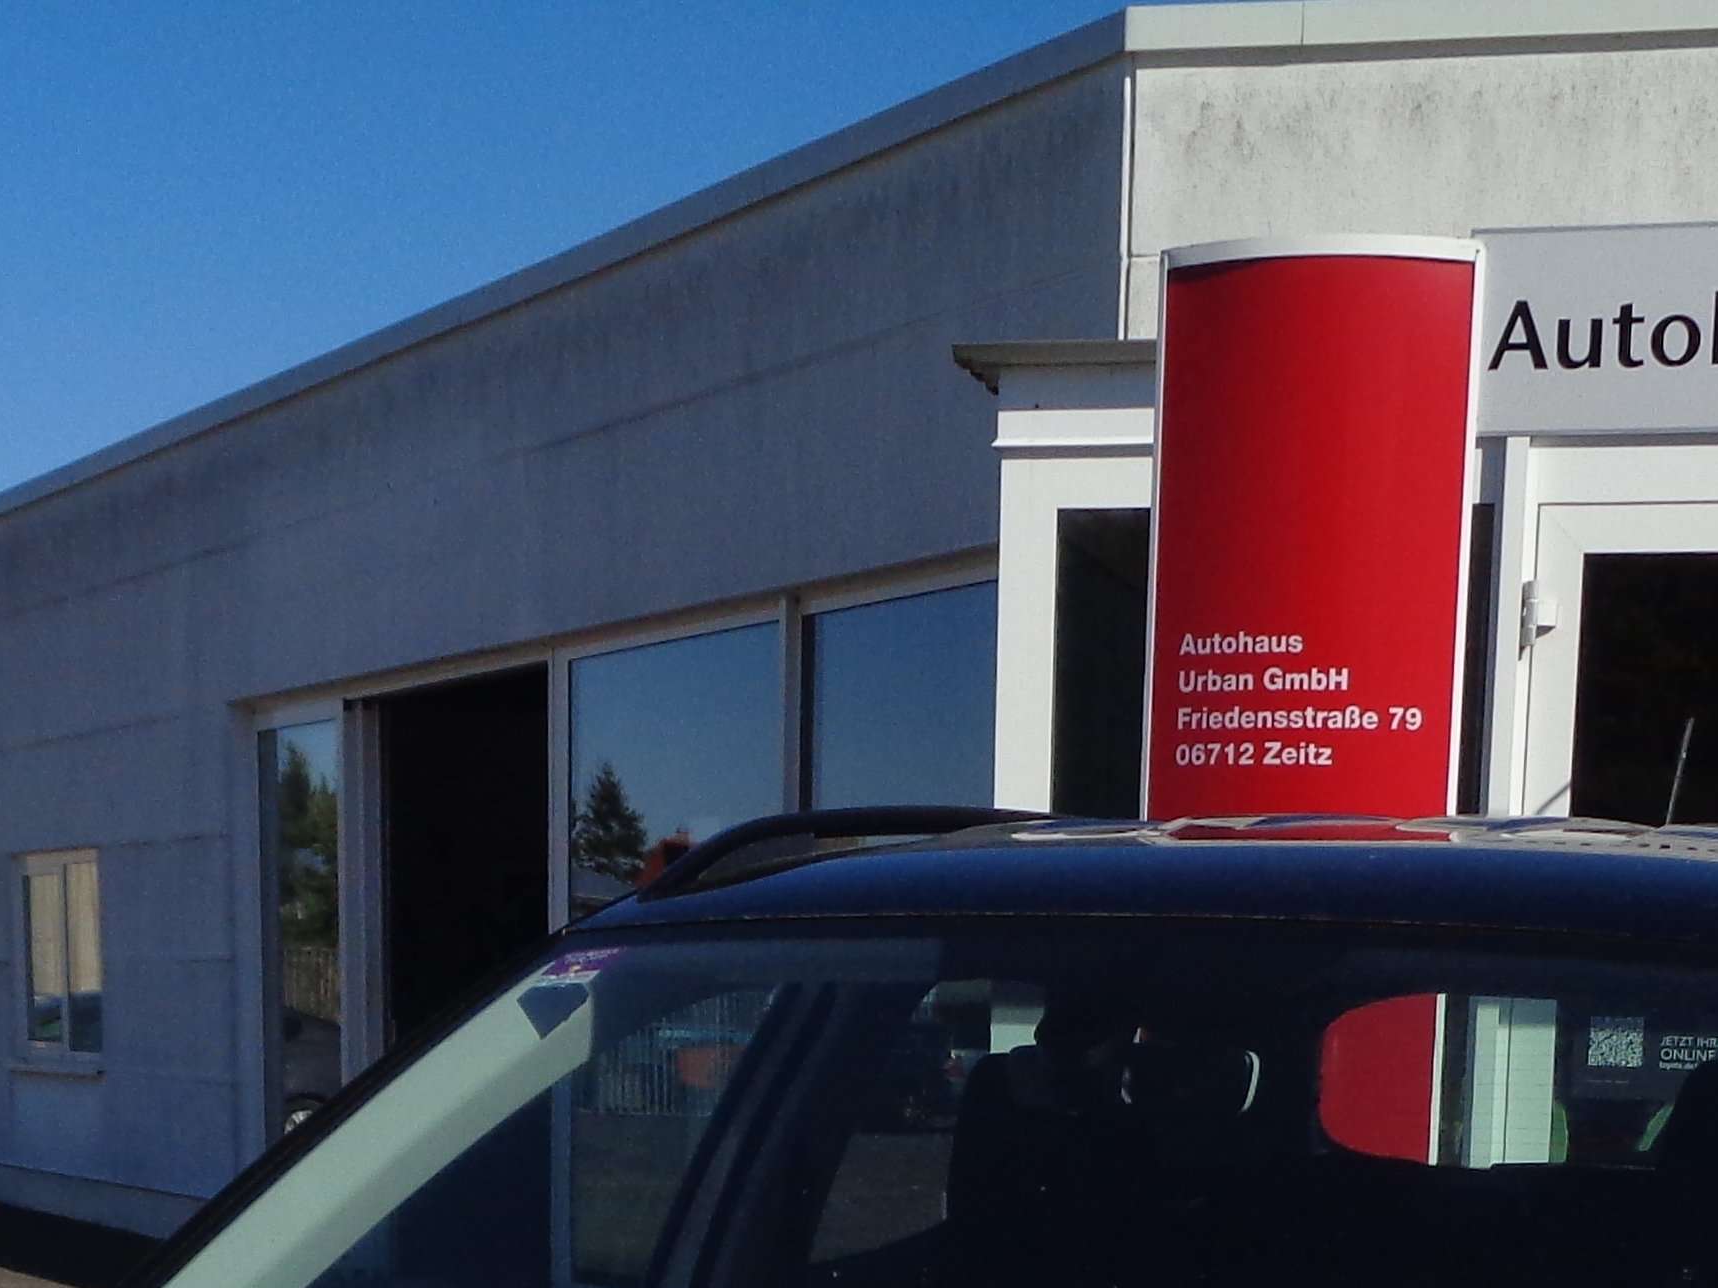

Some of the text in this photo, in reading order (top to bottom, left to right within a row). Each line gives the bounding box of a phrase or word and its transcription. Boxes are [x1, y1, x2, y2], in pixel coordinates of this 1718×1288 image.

[1179, 631, 1304, 656] Autohaus
[1178, 667, 1349, 693] Urban GmbH
[1177, 705, 1423, 731] Friedensstraße 79
[1175, 741, 1333, 766] 06712 Zeitz
[1660, 1035, 1694, 1047] JETZT
